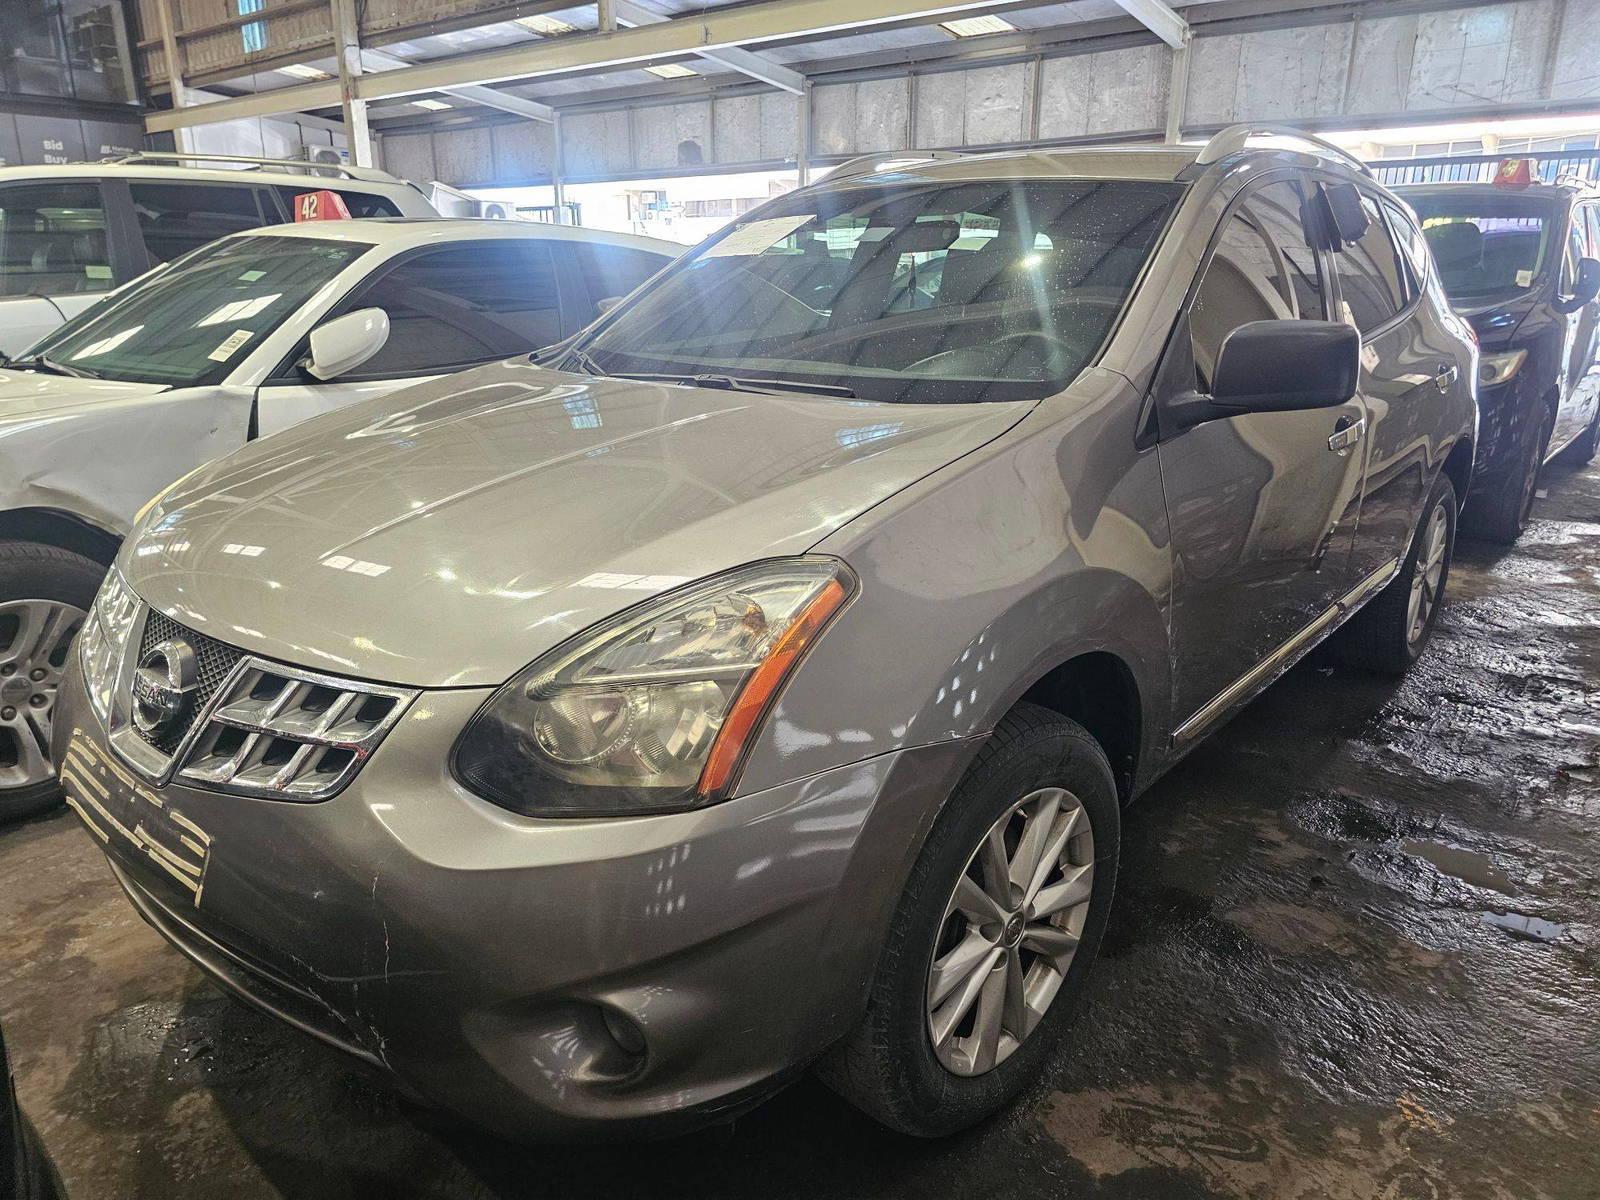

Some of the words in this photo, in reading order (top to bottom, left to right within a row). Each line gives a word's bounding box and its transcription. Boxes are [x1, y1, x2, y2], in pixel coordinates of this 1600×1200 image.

[43, 140, 64, 151] Bid
[44, 154, 68, 165] Buy
[301, 195, 319, 219] 42
[134, 677, 168, 706] SSAN
